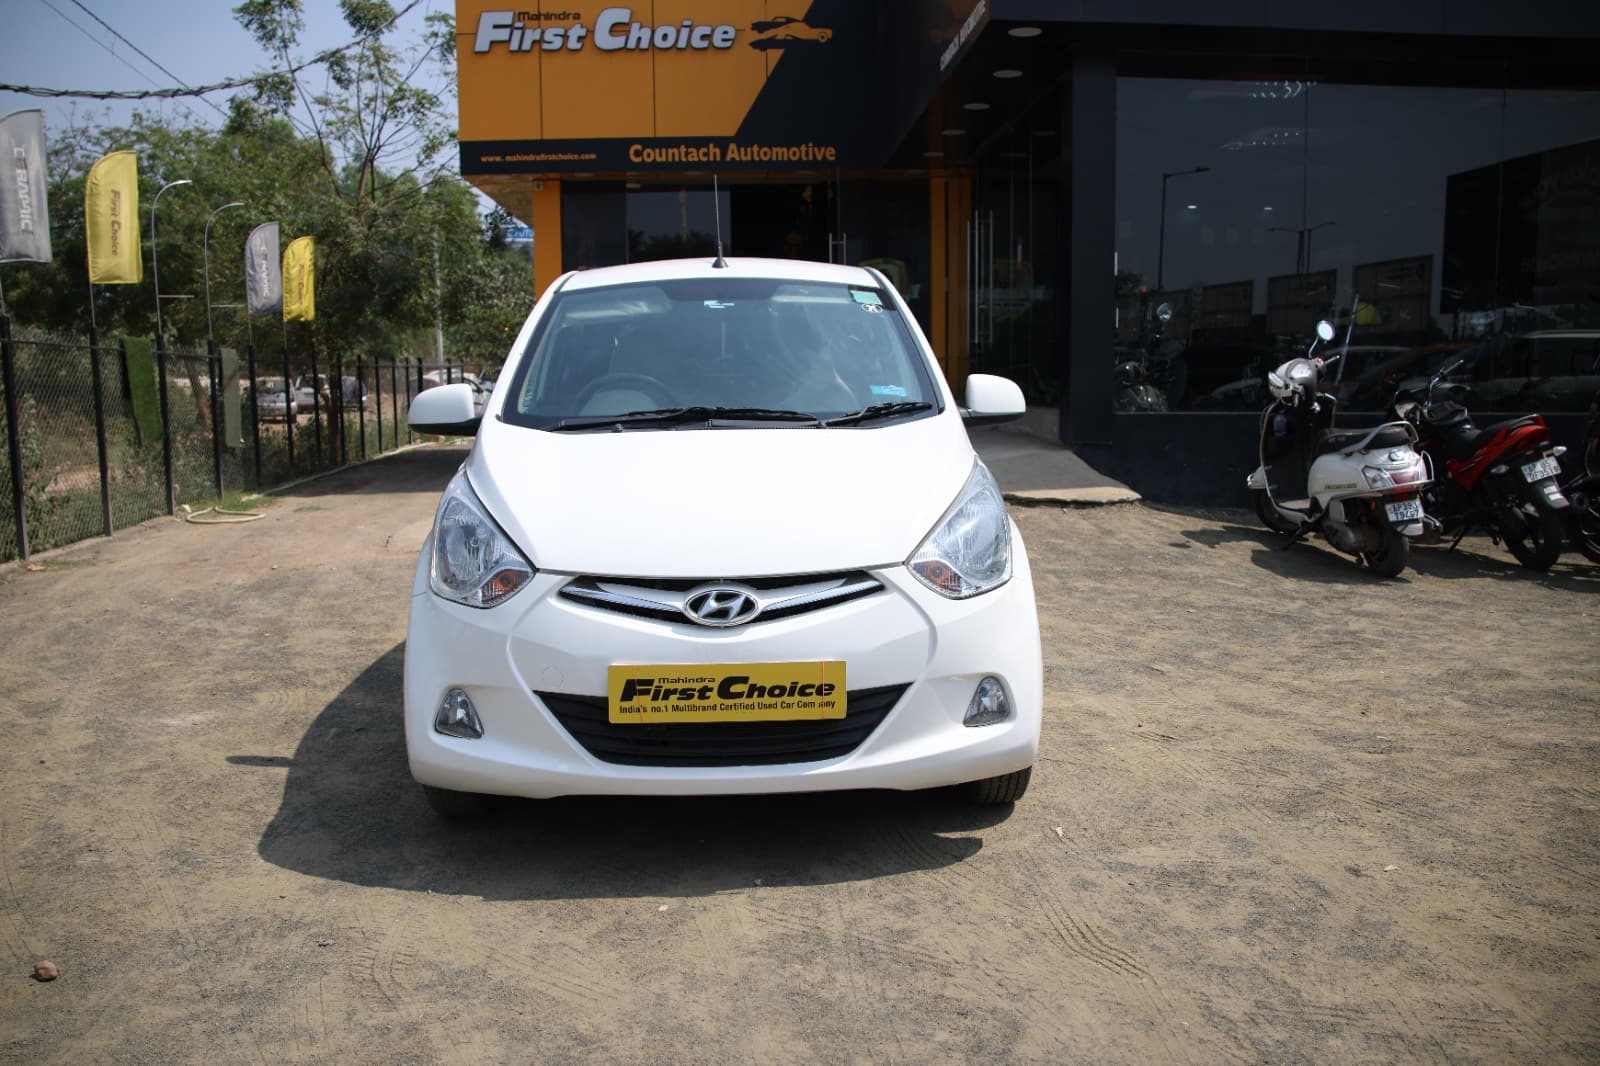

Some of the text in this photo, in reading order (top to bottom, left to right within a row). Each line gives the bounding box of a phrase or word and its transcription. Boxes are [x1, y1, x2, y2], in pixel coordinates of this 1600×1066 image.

[517, 11, 581, 20] Mahindra
[474, 7, 736, 52] First Choice
[628, 143, 836, 163] Countach Automotive
[658, 676, 716, 684] Mahindra
[619, 676, 836, 702] First Choice
[620, 703, 647, 713] India's
[651, 704, 668, 713] no.1
[672, 703, 717, 712] Multibrand
[720, 701, 755, 711] Certified
[757, 701, 778, 710] Used
[781, 701, 795, 709] Car
